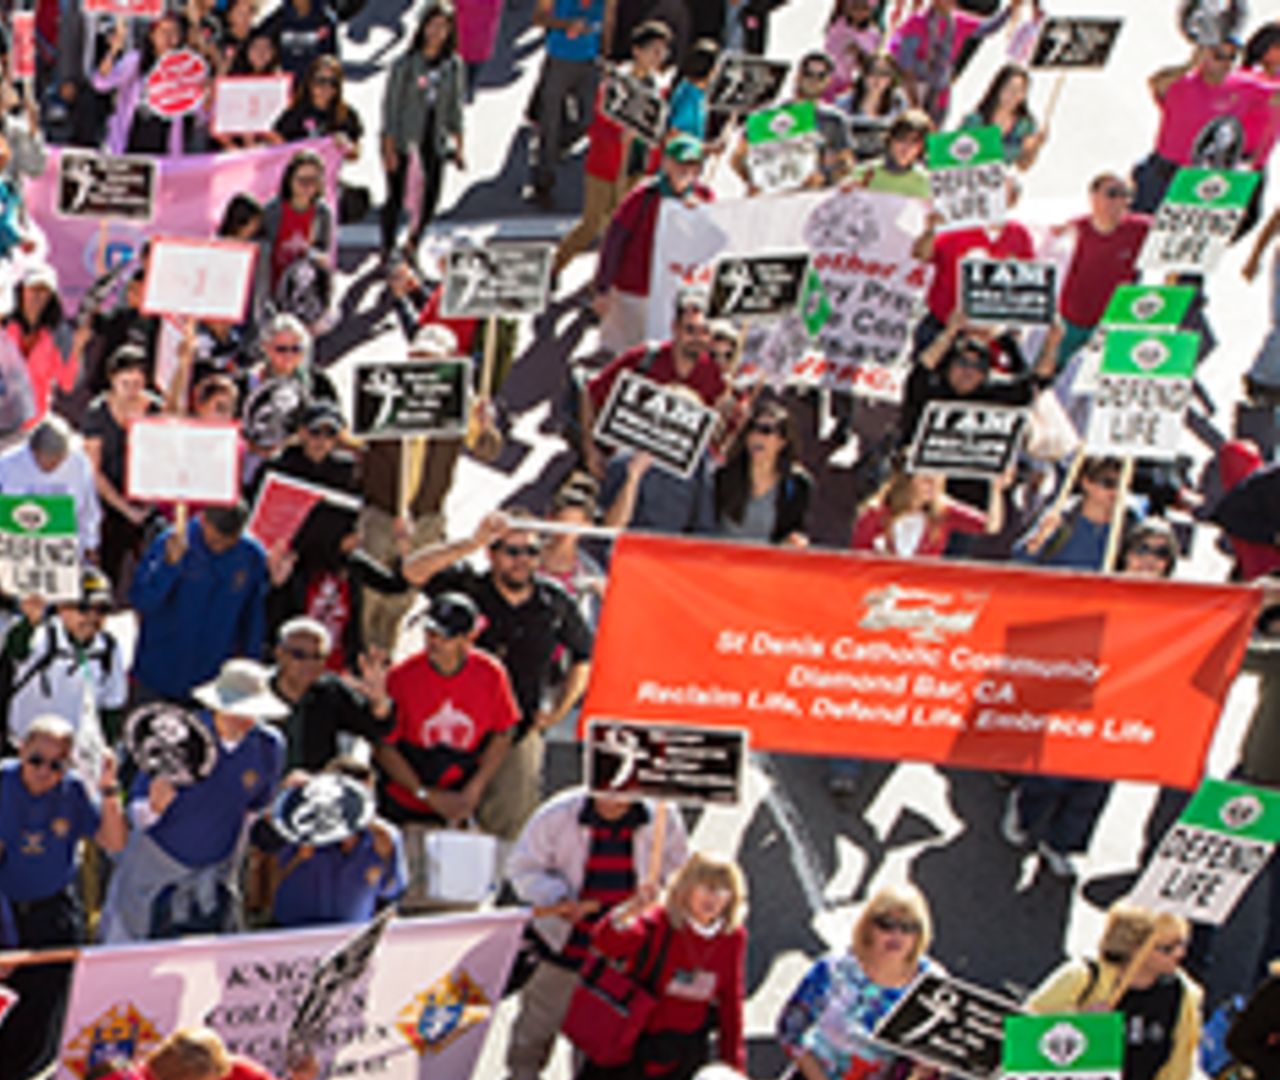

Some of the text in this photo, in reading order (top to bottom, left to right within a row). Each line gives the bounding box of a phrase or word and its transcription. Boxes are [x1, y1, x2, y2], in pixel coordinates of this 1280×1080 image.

[1109, 413, 1160, 445] LIFE
[716, 630, 1110, 685] St Denis Catholic Community
[786, 664, 1016, 705] Diamond Bar, CA
[638, 681, 1156, 743] Reclaim Life, Defend Life, Embrace Life
[1159, 828, 1266, 875] DEFEND
[1159, 866, 1224, 907] LIFE
